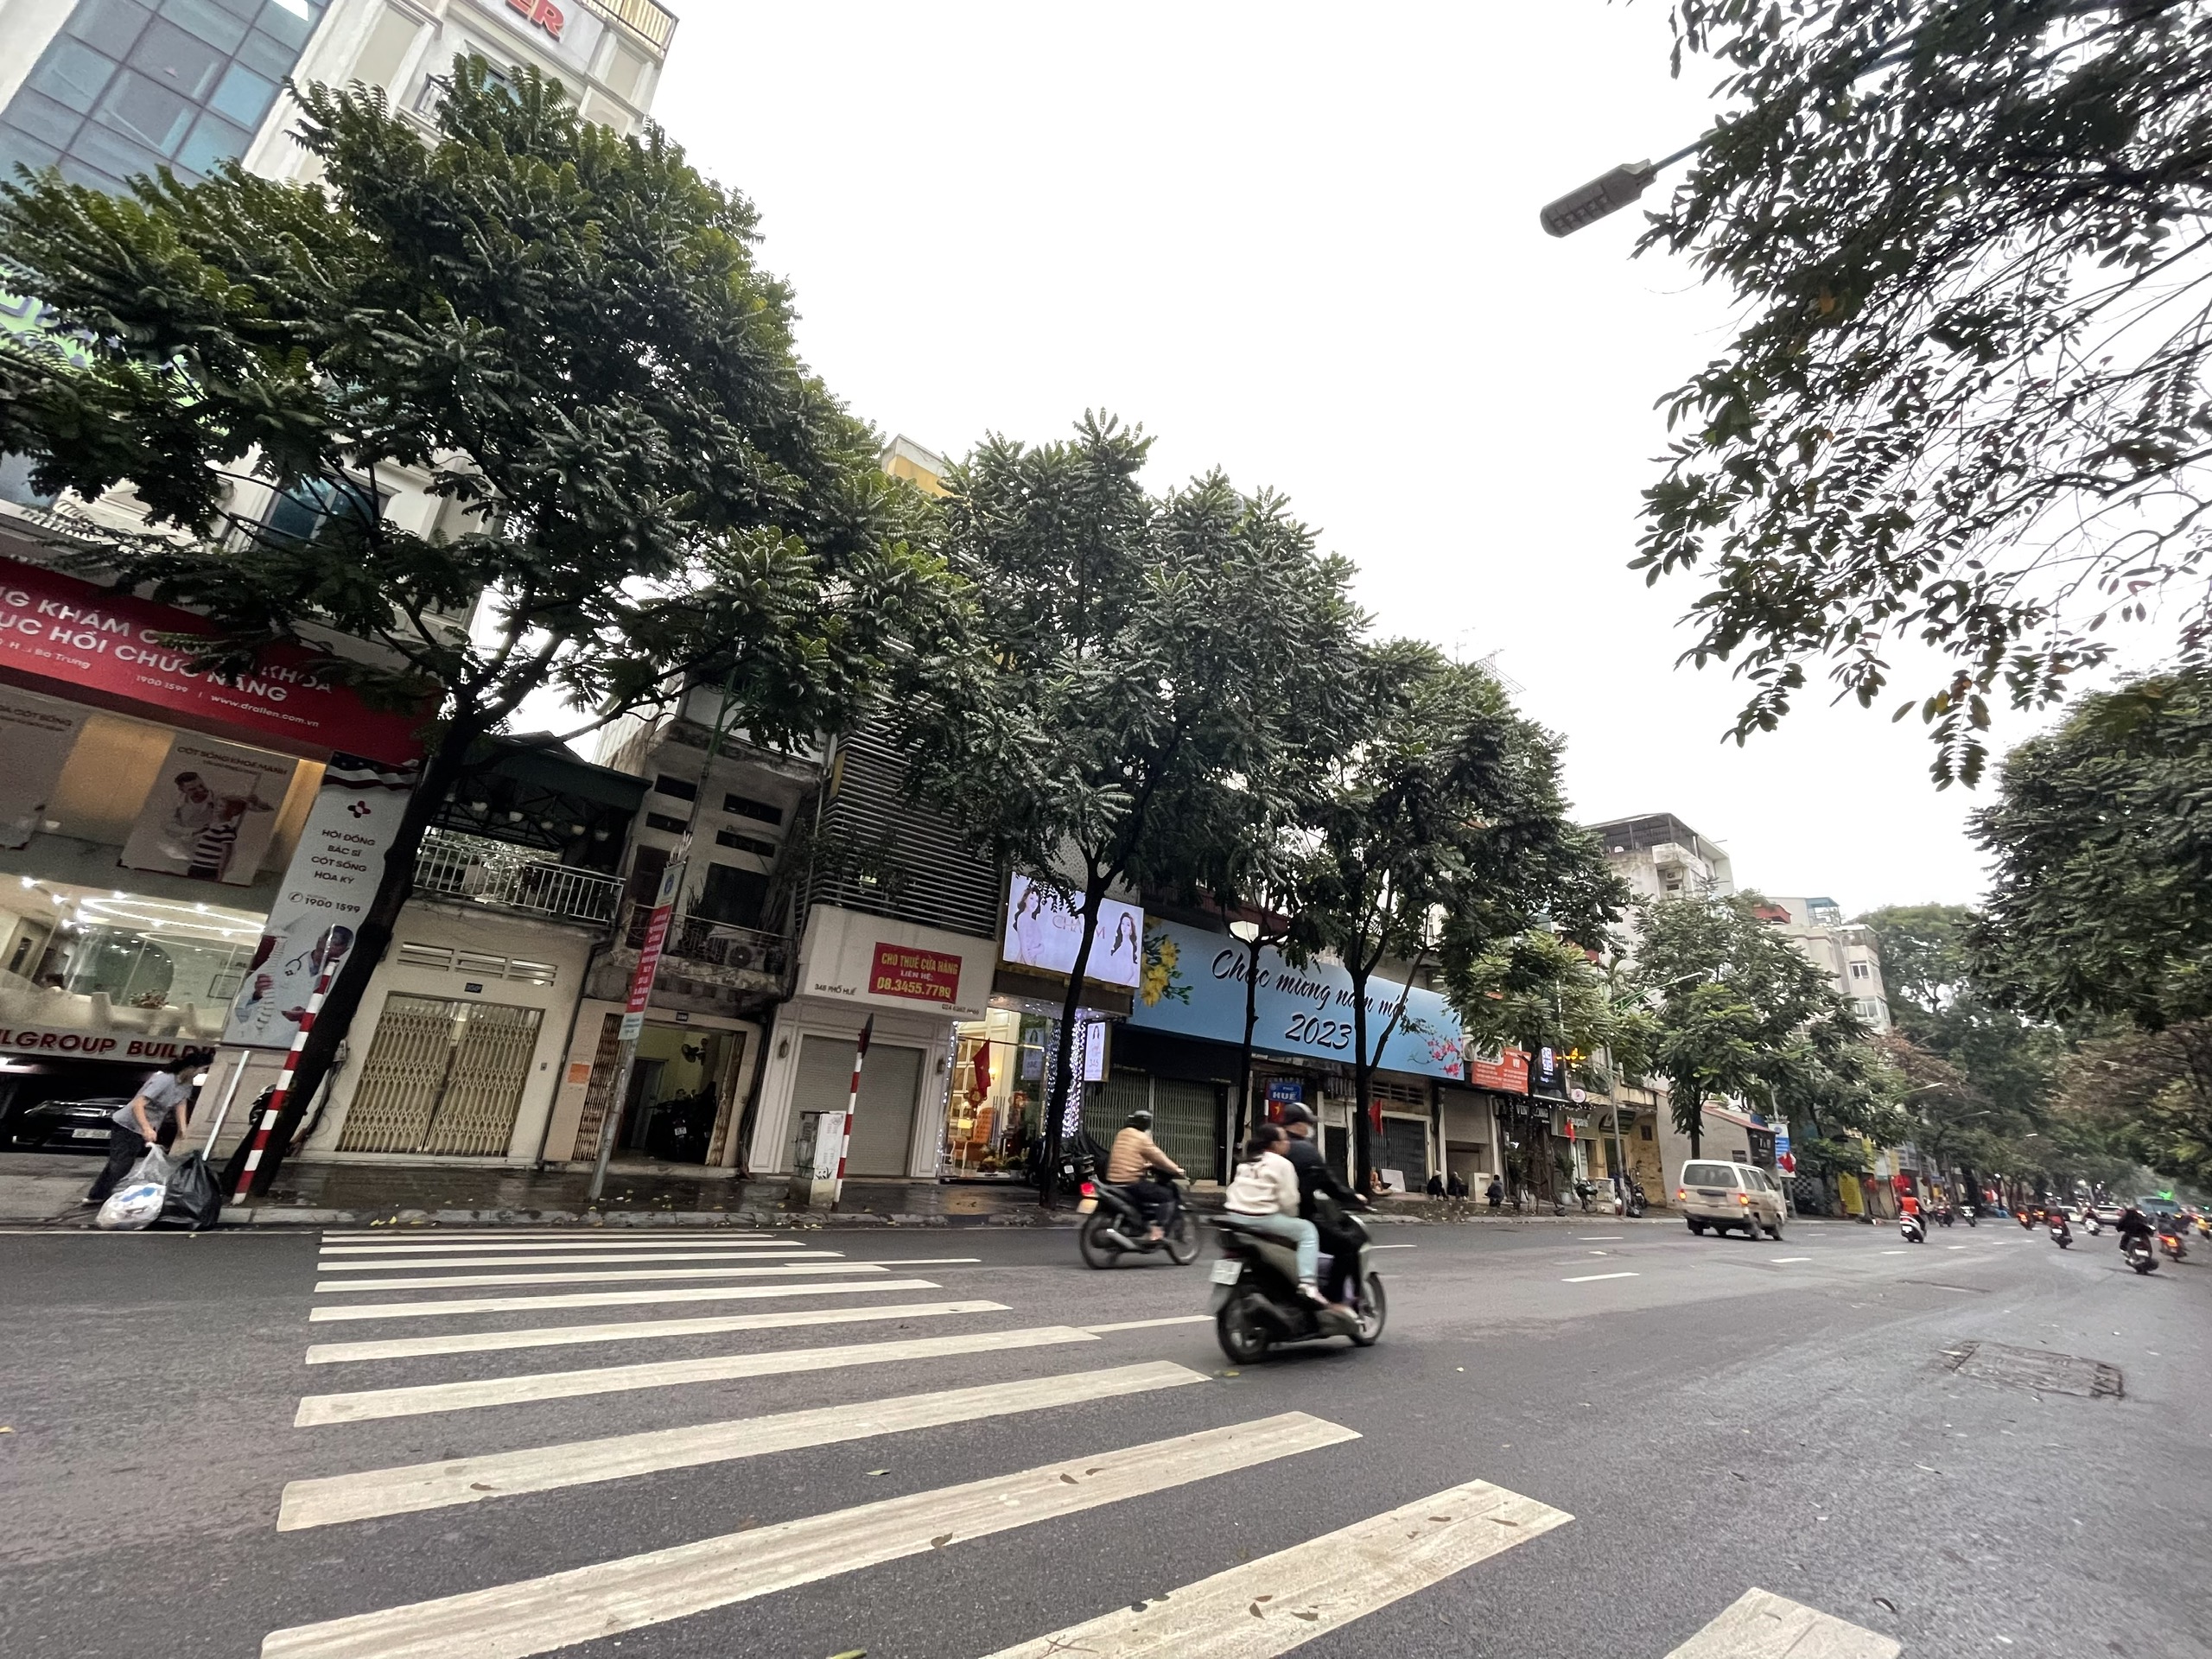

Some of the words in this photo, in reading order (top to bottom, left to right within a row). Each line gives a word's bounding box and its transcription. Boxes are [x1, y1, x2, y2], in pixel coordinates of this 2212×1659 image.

[0, 587, 30, 607] G
[37, 599, 130, 638] KHÁM
[321, 829, 342, 840] HỘI
[327, 843, 350, 855] BÁC
[335, 860, 367, 873] SỐNG
[305, 897, 333, 908] 1900
[335, 902, 361, 913] 1599
[1052, 914, 1106, 940] CHAM
[881, 952, 899, 967] CHO
[899, 954, 920, 969] THUÊ
[938, 960, 960, 976] HÀNG
[827, 984, 842, 994] PHỐ
[876, 976, 953, 998] 08.3455.7789
[0, 1028, 117, 1054] LGROUP
[1284, 1013, 1353, 1051] 2023
[1272, 1091, 1298, 1101] HUẾ
